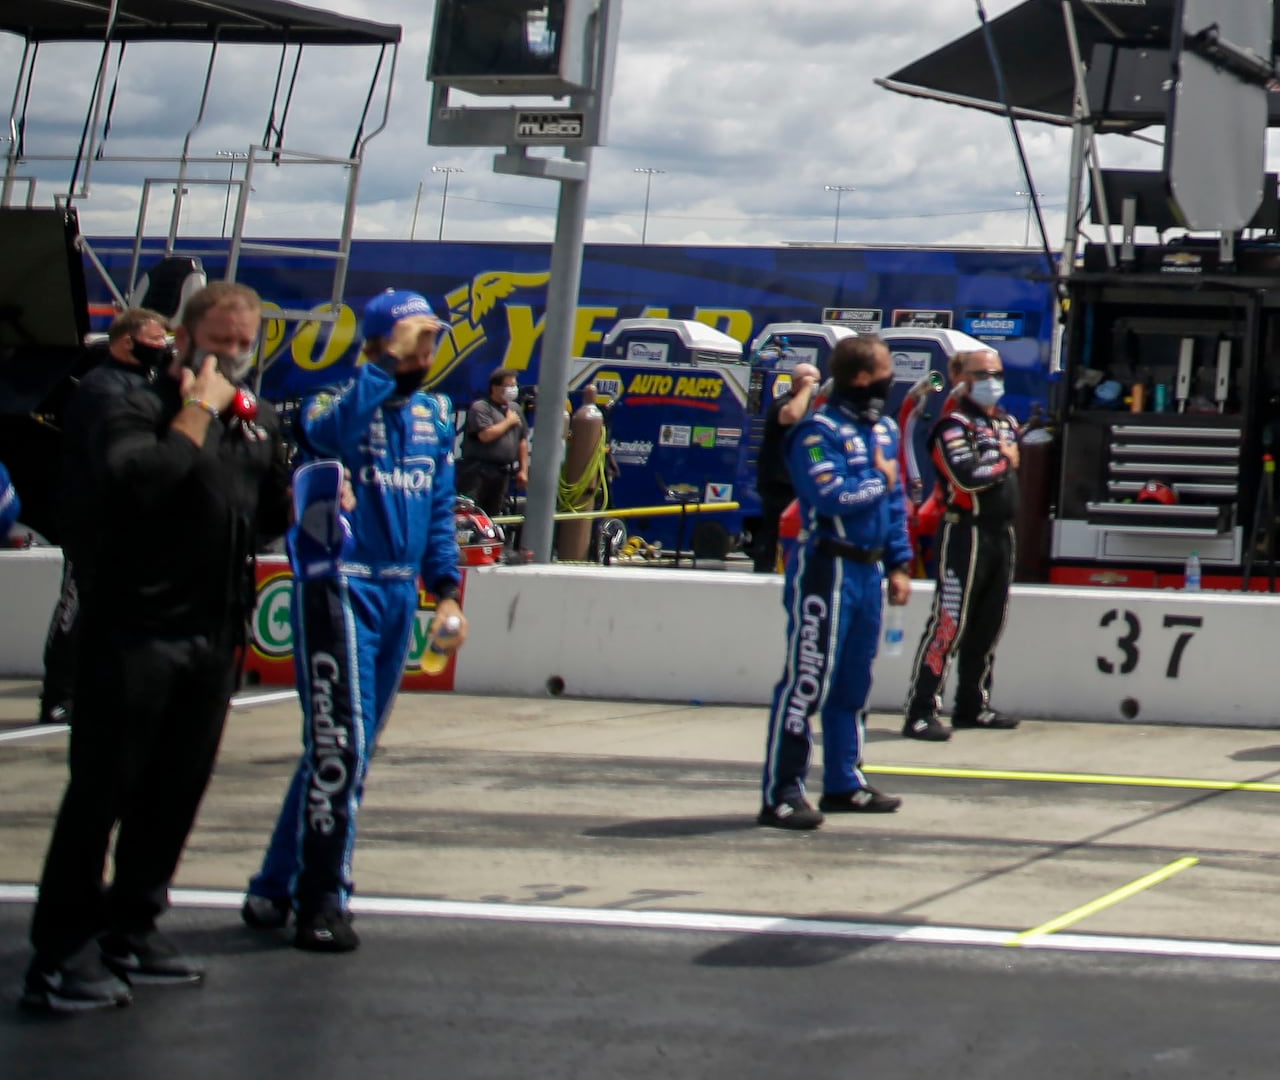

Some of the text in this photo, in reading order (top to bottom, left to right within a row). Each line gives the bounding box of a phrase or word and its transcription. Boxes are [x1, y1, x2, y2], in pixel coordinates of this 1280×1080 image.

[972, 321, 1015, 330] GANDER
[628, 374, 673, 395] AUTO
[674, 377, 724, 398] PARTS
[784, 594, 828, 735] CreditOne
[1097, 609, 1203, 678] 37
[311, 651, 348, 835] CreditOne
